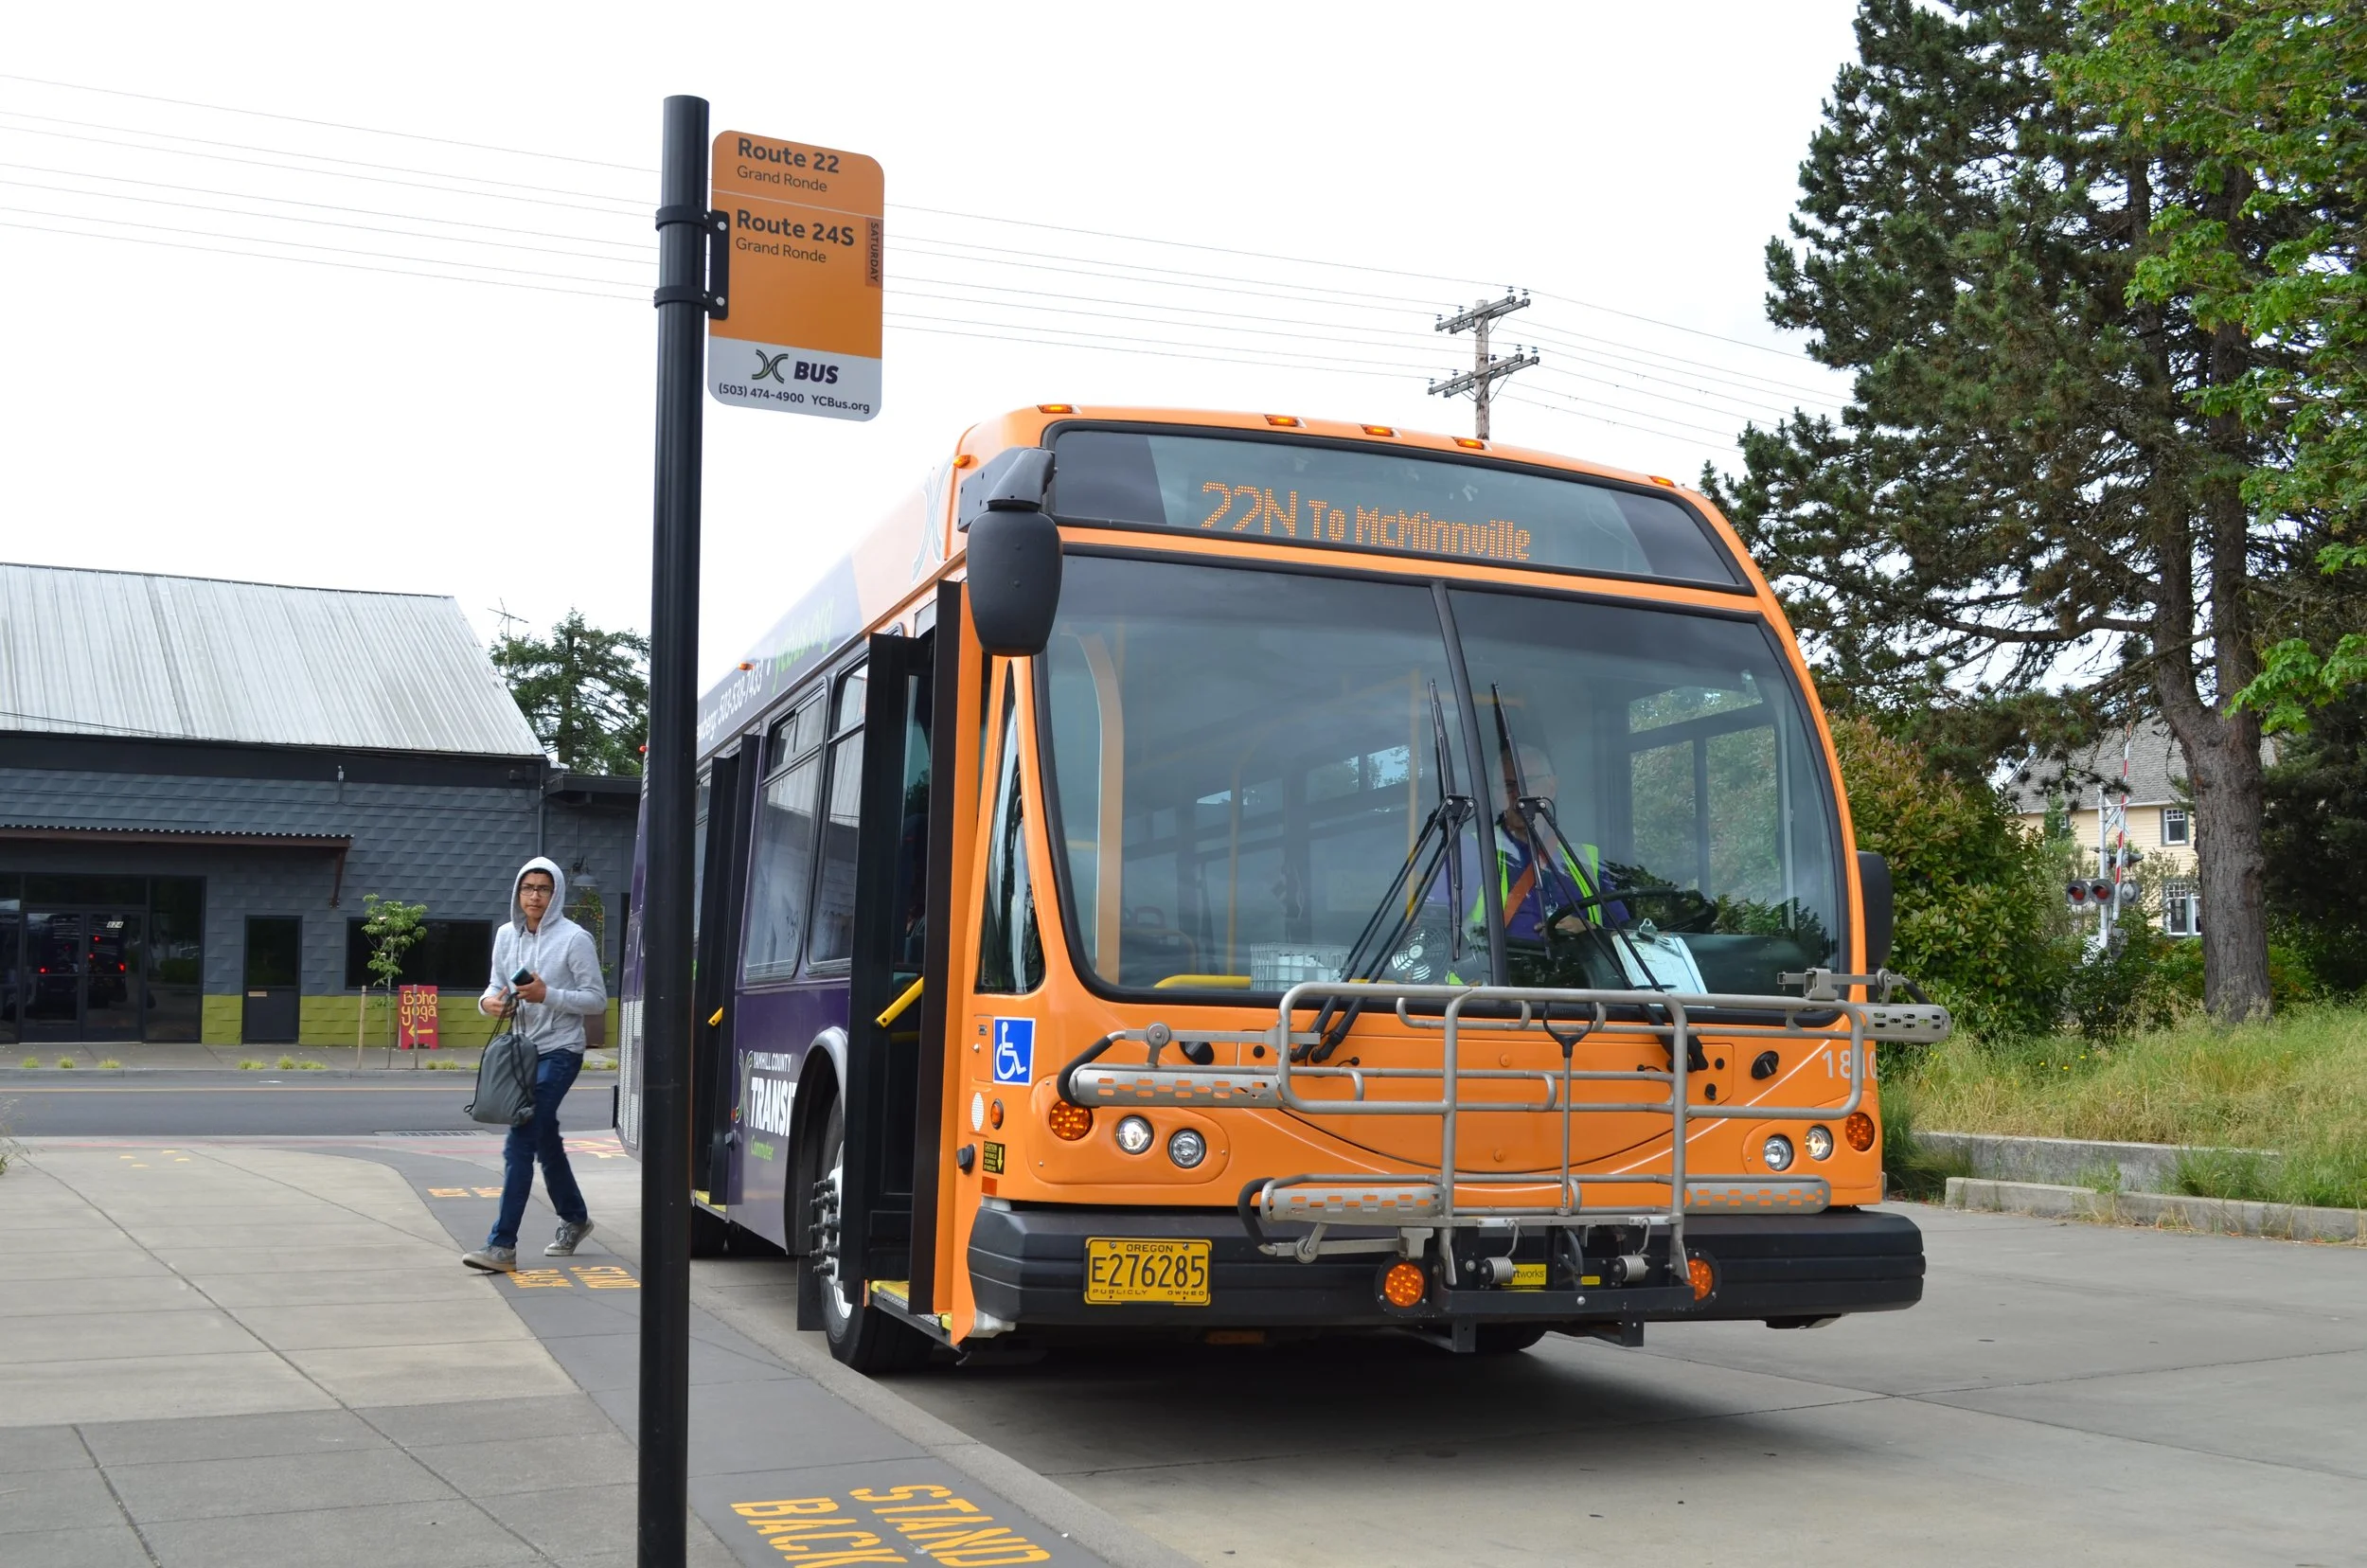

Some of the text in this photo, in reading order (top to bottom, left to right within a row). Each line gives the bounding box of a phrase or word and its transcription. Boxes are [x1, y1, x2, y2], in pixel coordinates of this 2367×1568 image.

[738, 137, 840, 173] Route 22
[737, 165, 828, 192] Grand Ronde
[737, 209, 855, 246] Route 24S
[736, 237, 827, 263] Grand Ronde
[870, 222, 880, 283] SATURDAY
[793, 361, 839, 384] BUS
[718, 383, 870, 415] (503) 474-4900 YCBus.org
[1201, 482, 1531, 561] 22N To McMinnville
[403, 989, 437, 1005] Boho
[401, 1005, 437, 1026] yoga
[771, 1053, 792, 1073] COUNTY
[1126, 1243, 1174, 1253] OREGON
[1091, 1254, 1206, 1289] E276285
[1513, 1270, 1544, 1278] rtworks
[730, 1497, 909, 1568] BACK
[849, 1485, 1051, 1567] STAND
